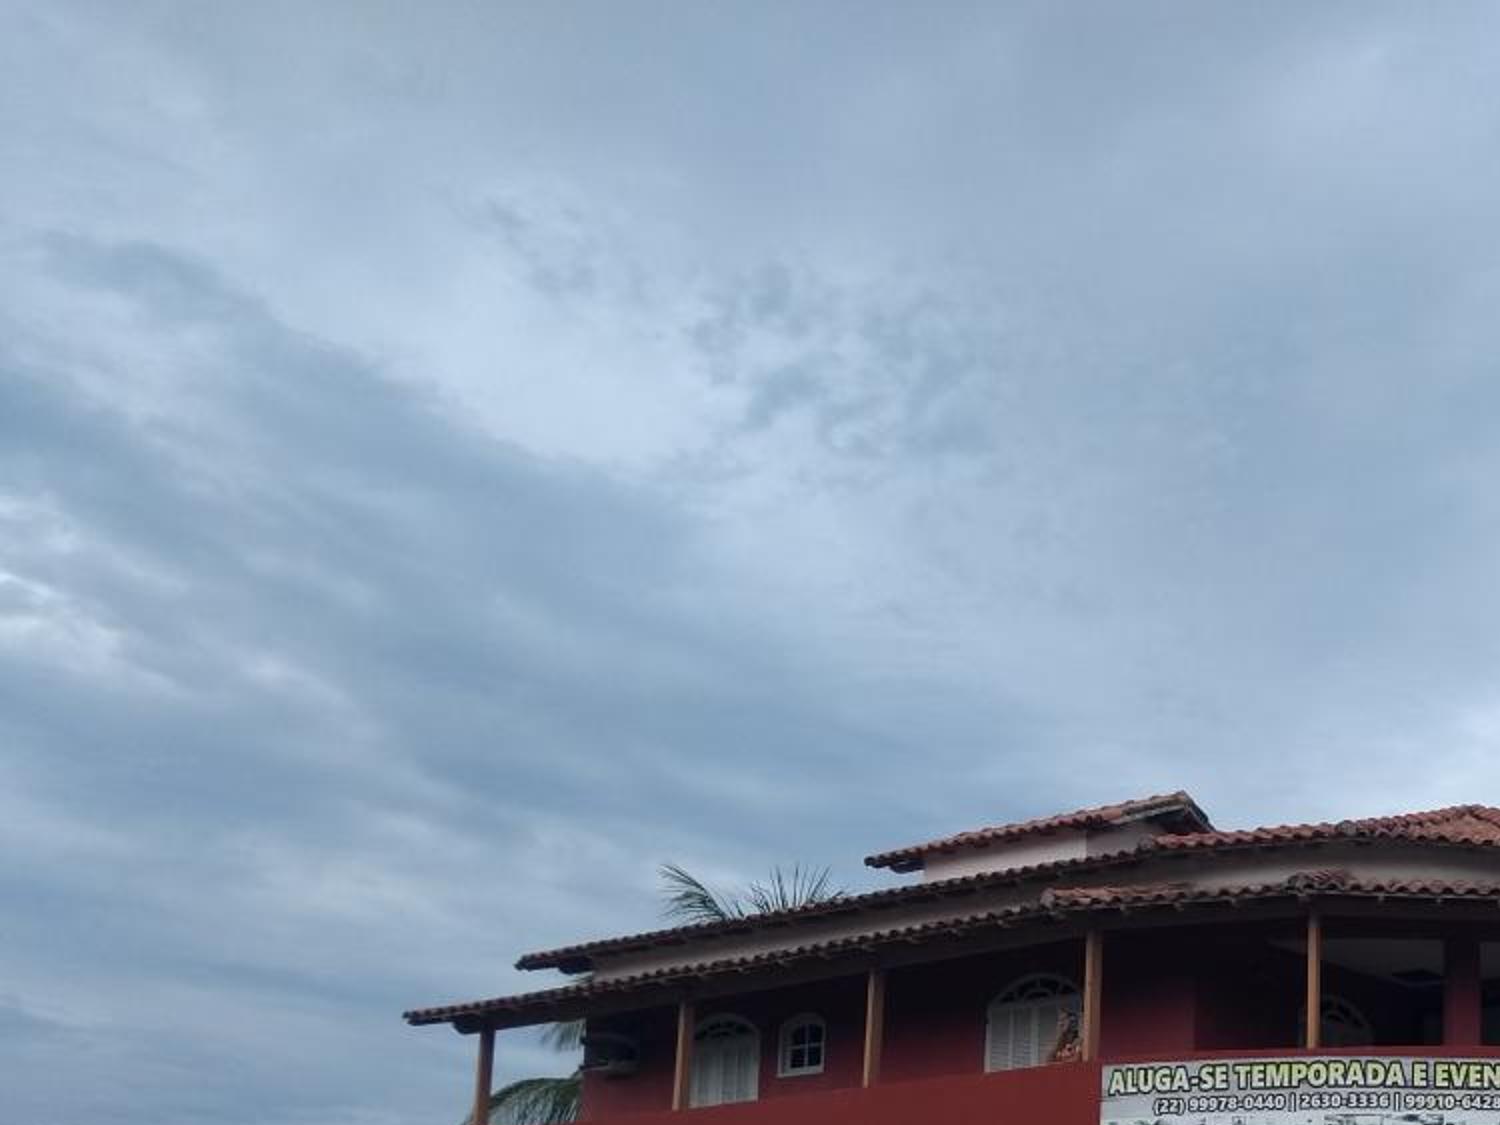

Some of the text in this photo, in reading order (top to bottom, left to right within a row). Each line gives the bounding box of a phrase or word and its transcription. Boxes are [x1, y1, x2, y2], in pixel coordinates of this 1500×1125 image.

[1109, 1065, 1229, 1096] ALUGA-SE
[1234, 1060, 1406, 1090] TEMPORADA
[1412, 1061, 1429, 1088] E
[1153, 1098, 1186, 1116] (22)
[1187, 1095, 1286, 1112] 99978-0440
[1300, 1092, 1389, 1109] 2630-3336
